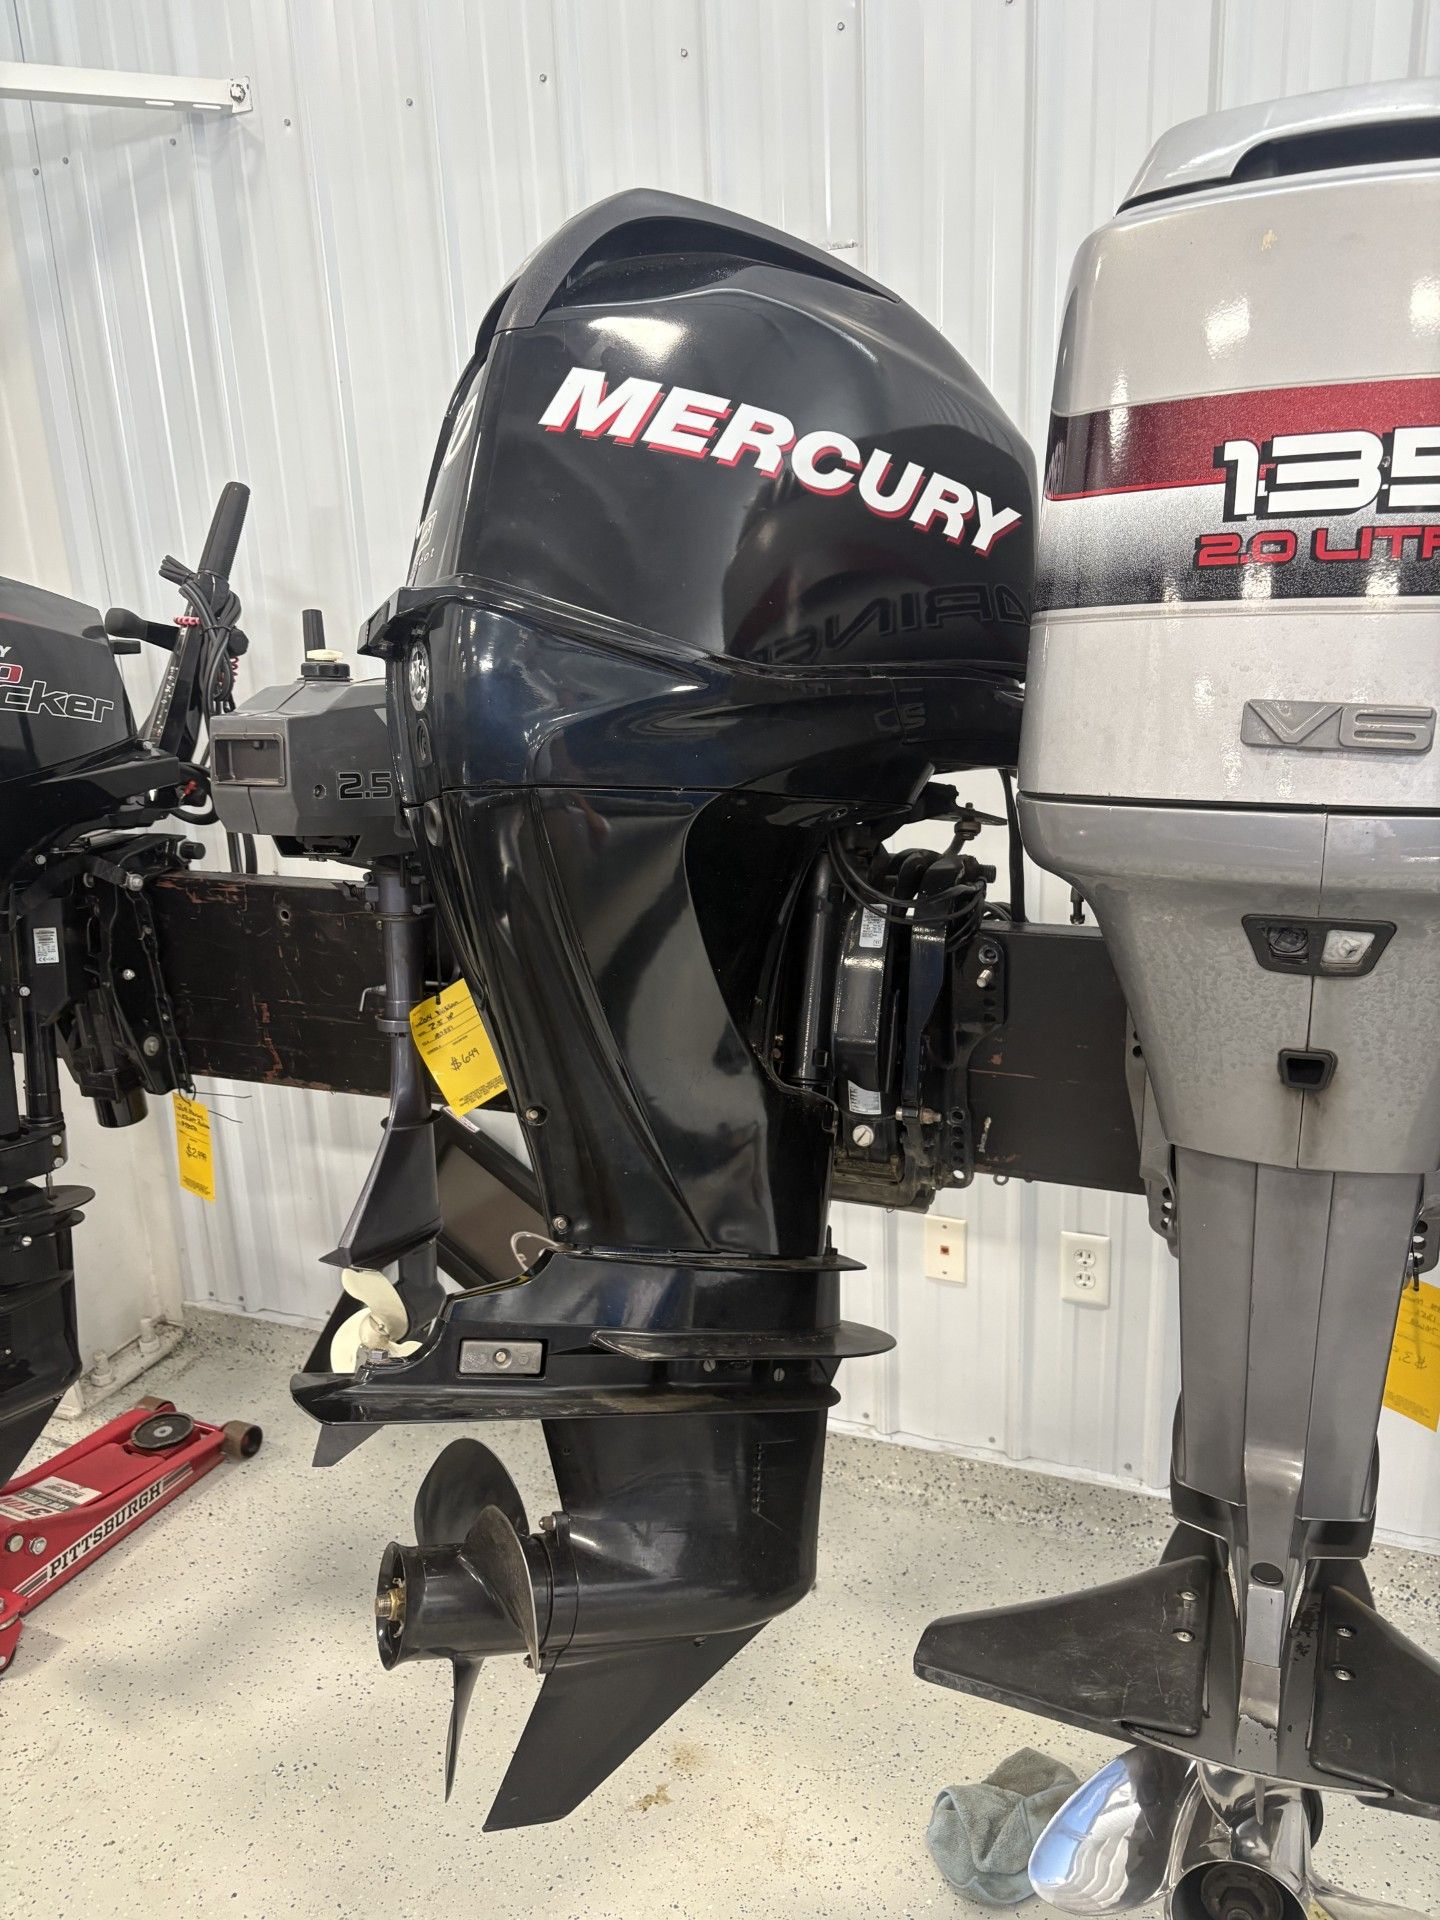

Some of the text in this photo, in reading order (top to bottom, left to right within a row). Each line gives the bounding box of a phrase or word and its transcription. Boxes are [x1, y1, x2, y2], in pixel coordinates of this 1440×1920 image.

[538, 366, 1023, 557] MERCURY
[1193, 530, 1298, 569] 2.0
[1243, 699, 1438, 754] V6
[337, 770, 392, 800] 2.5
[450, 1047, 480, 1072] $649
[48, 1480, 164, 1581] PITTSBURGH
